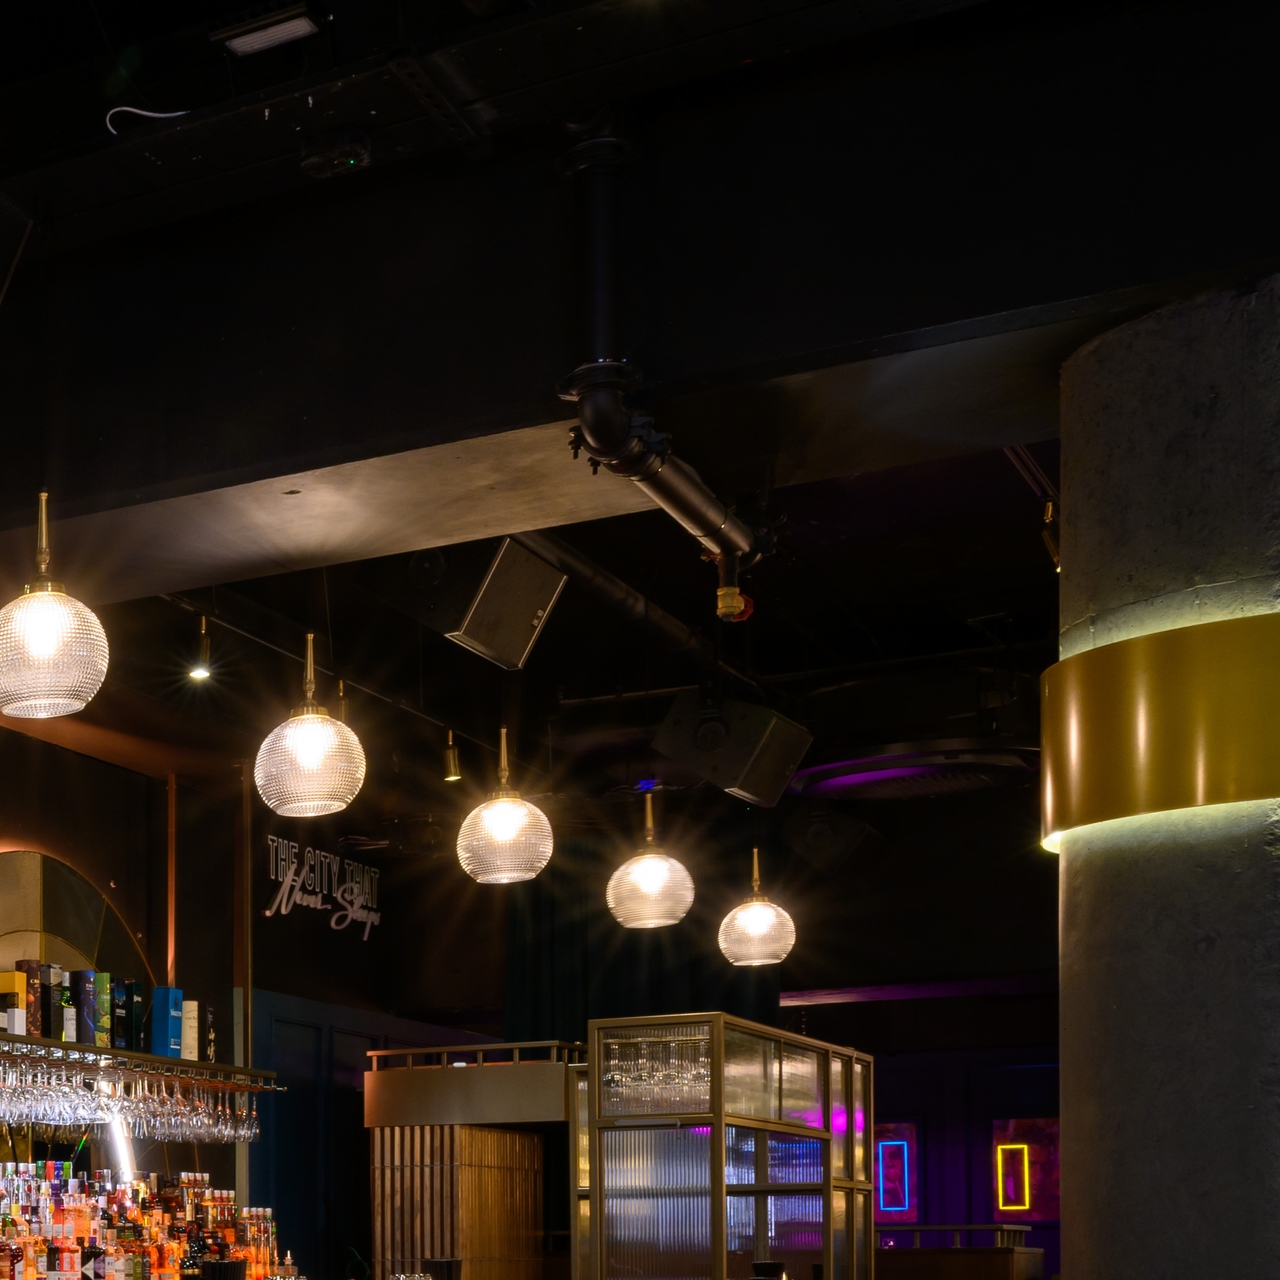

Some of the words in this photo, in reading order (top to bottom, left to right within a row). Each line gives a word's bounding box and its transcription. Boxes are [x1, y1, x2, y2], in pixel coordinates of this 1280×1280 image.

[268, 834, 298, 886] THE
[304, 847, 340, 897] CITY
[344, 860, 380, 908] THAT
